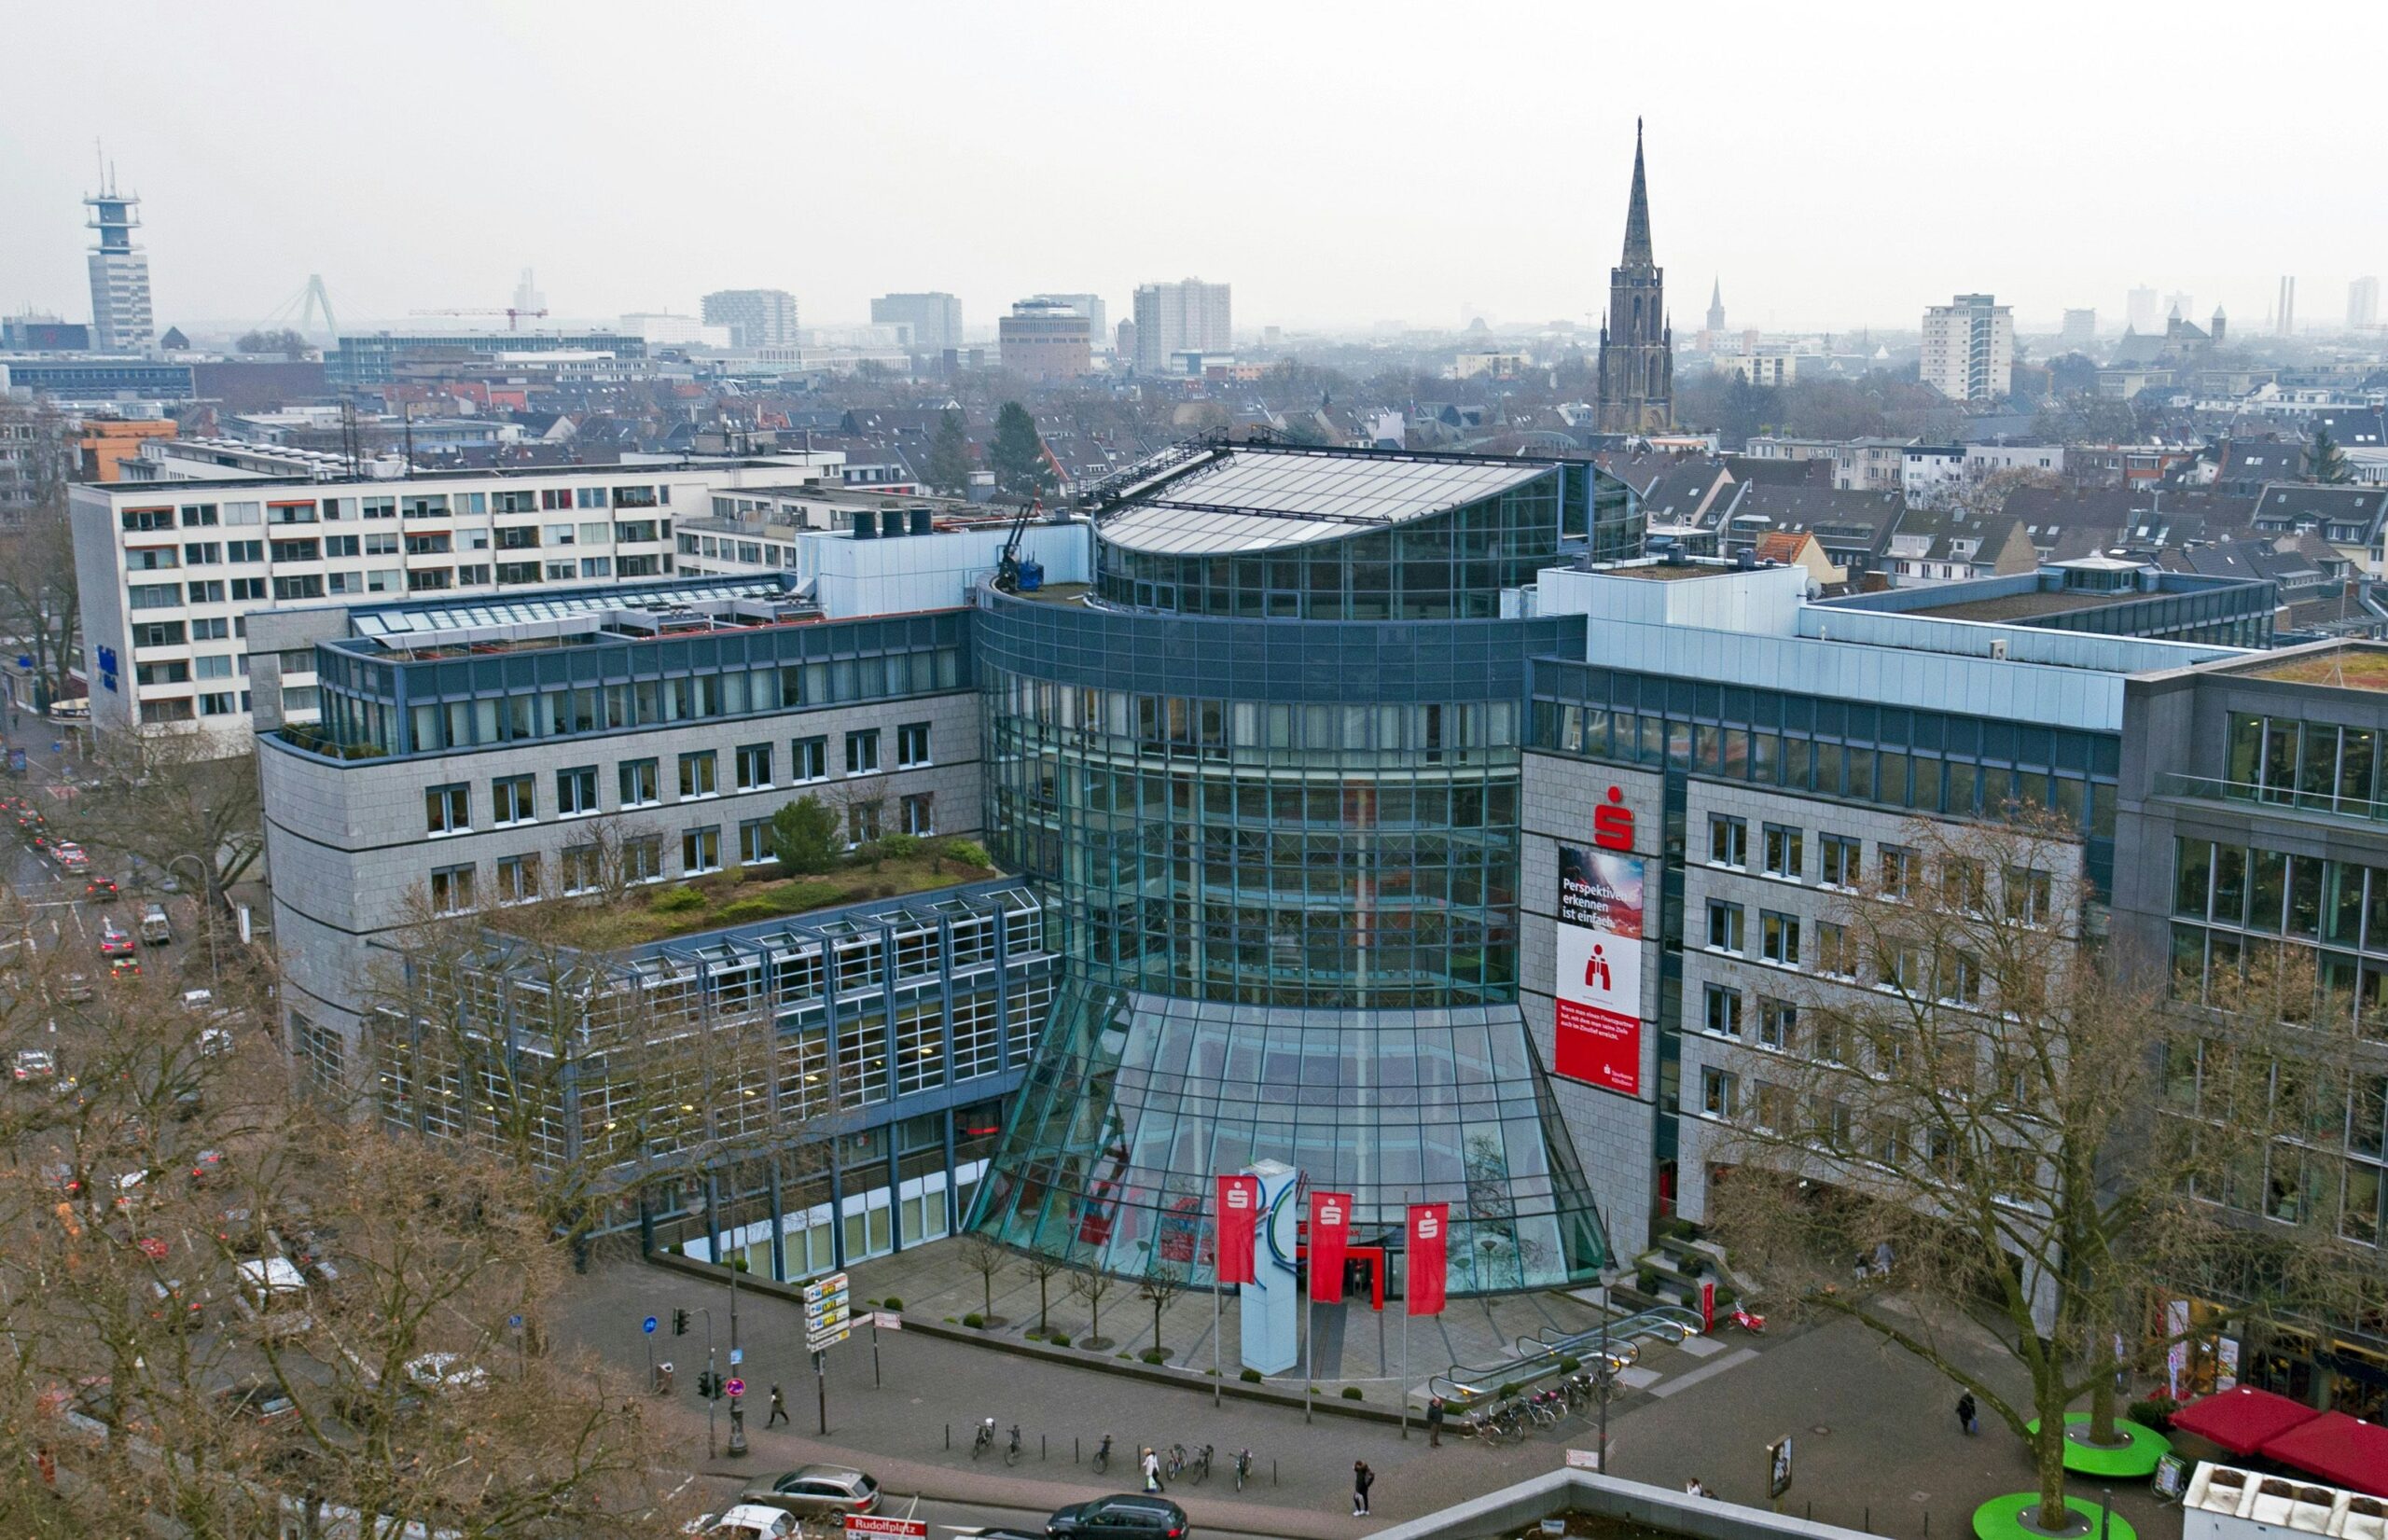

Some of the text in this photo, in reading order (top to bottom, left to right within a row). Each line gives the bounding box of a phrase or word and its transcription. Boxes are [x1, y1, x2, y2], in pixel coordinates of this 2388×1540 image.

[1562, 878, 1628, 902] Perspektiven
[1562, 894, 1609, 912] erkennen
[1562, 906, 1616, 928] ist einfach.
[854, 1518, 916, 1534] Rudolfplatz
